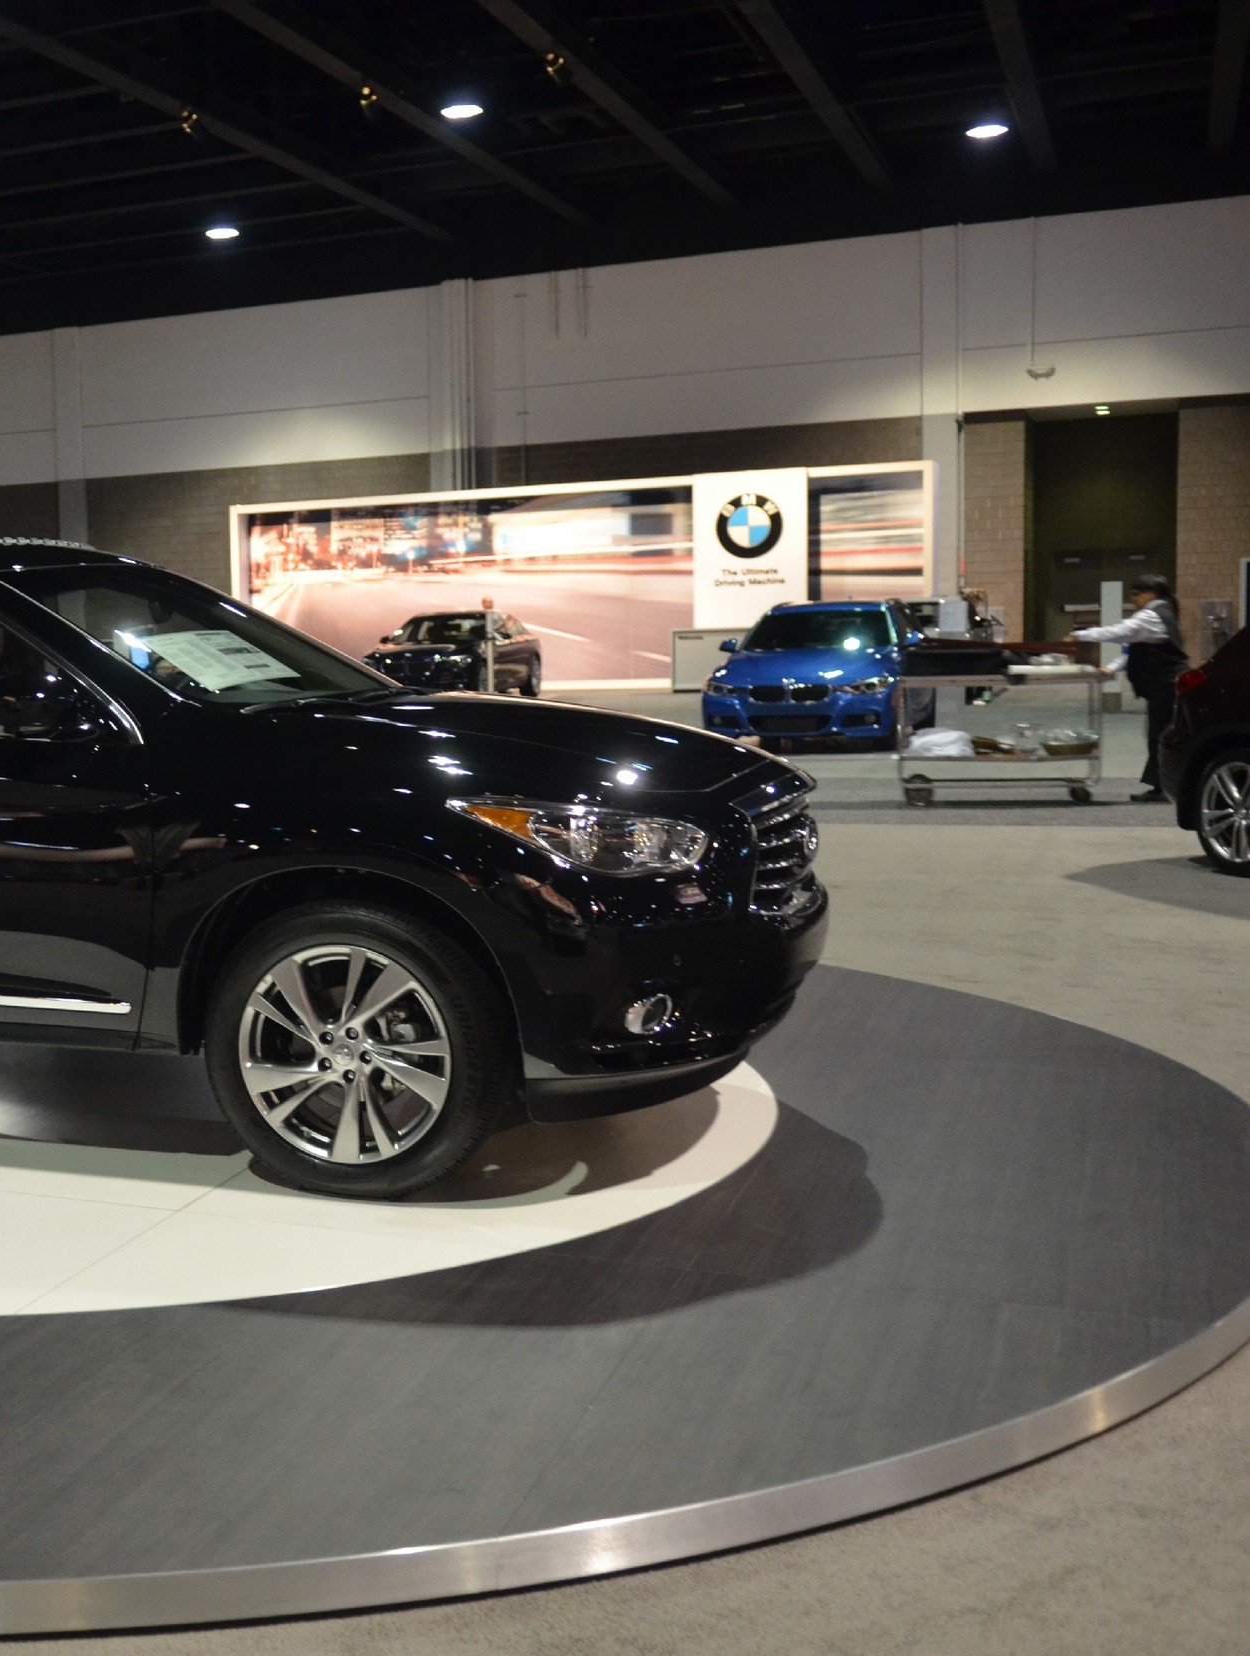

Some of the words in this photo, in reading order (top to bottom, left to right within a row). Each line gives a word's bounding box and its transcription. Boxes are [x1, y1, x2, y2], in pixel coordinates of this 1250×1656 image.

[720, 493, 780, 517] BMW
[714, 579, 744, 587] Driving
[748, 577, 785, 585] Machine
